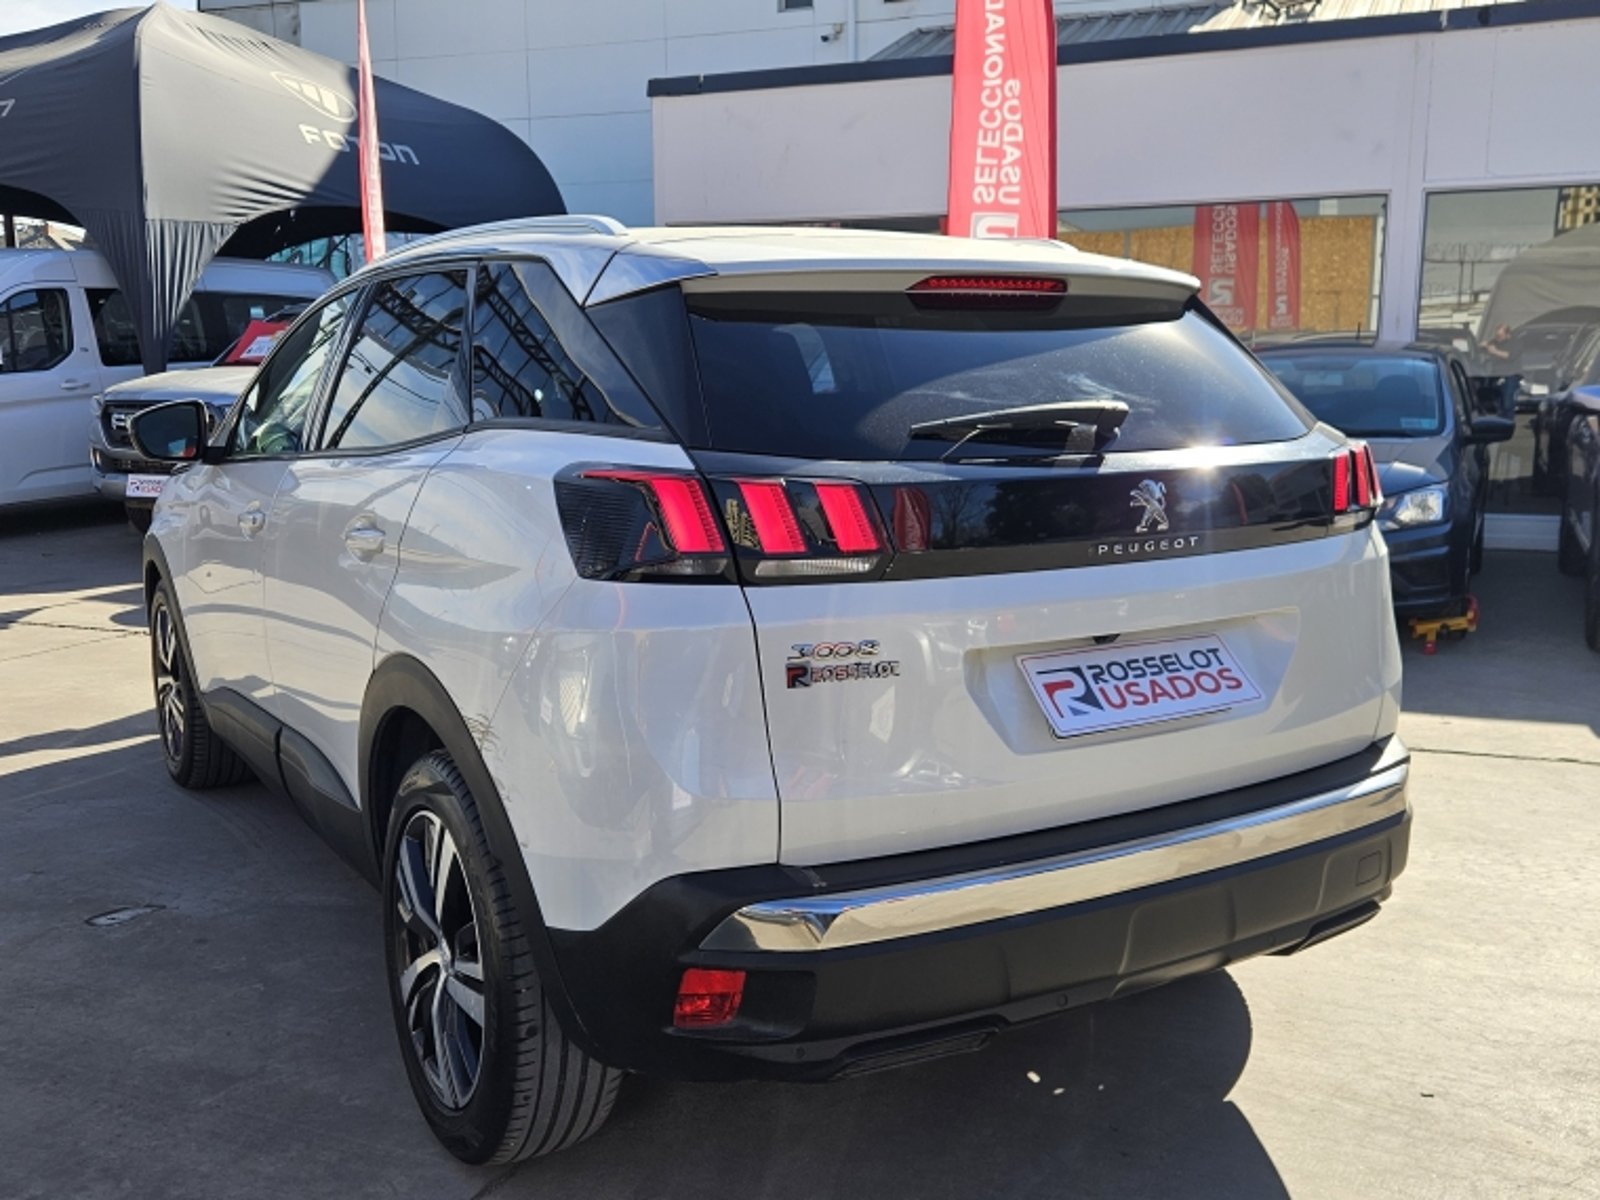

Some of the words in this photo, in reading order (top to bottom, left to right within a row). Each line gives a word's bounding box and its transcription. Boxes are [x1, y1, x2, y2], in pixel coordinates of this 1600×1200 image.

[1098, 536, 1199, 555] PEUGEOT
[787, 639, 880, 661] 3008
[1086, 648, 1225, 685] ROSSELOT
[1099, 667, 1244, 710] USADOS
